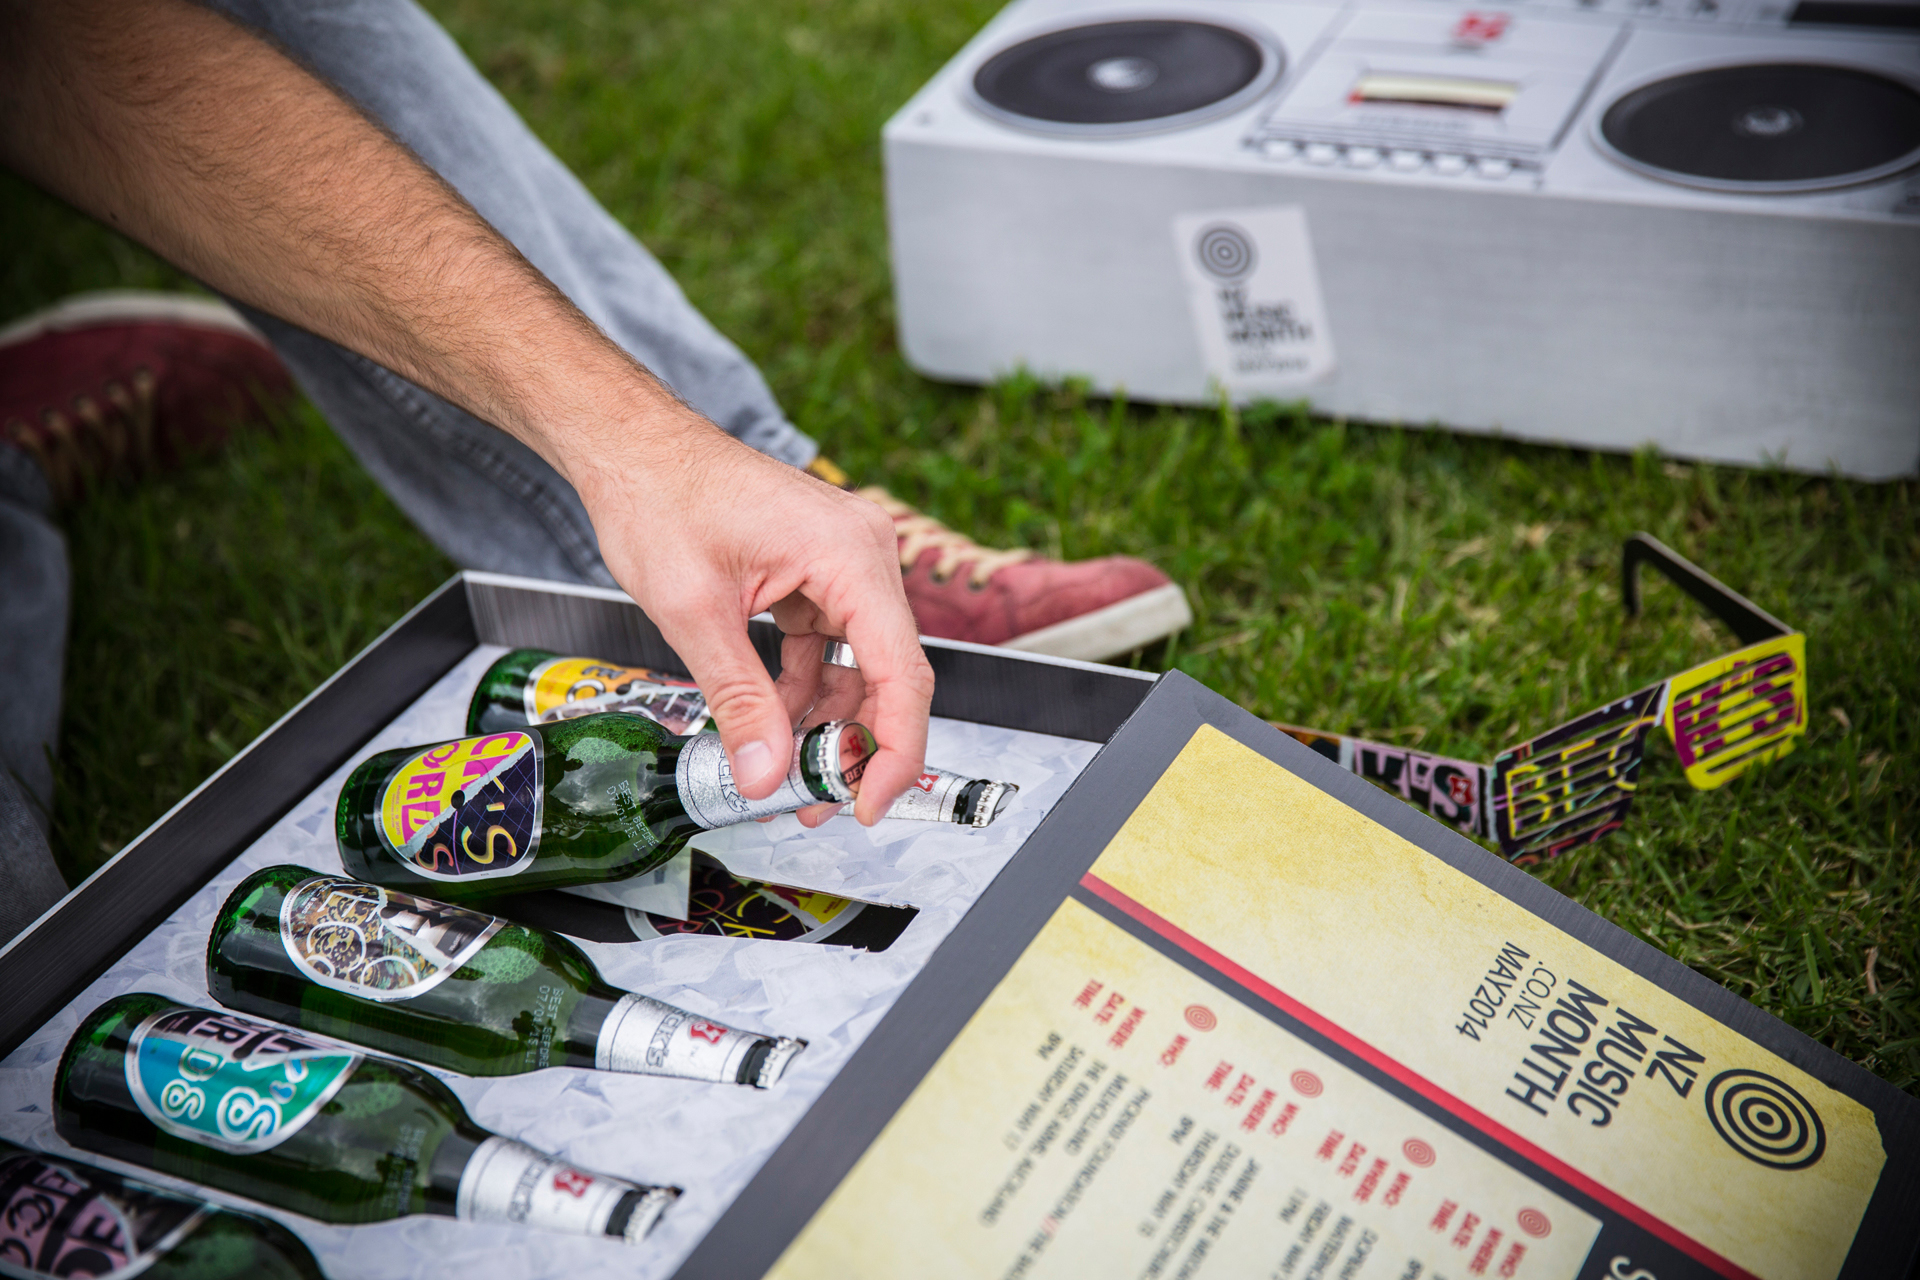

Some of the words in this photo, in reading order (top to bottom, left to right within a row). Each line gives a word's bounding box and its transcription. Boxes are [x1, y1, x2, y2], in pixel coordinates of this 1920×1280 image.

[1072, 978, 1103, 1012] TIME:
[1092, 991, 1125, 1028] DATE:
[1454, 940, 1529, 1042] MAY2014
[1506, 960, 1560, 1030] .CO.NZ
[1105, 1004, 1146, 1053] WHERE:
[1504, 978, 1609, 1117] MONTH
[1156, 1032, 1190, 1071] WHO:
[1562, 1007, 1658, 1131] MUSIC
[1644, 1034, 1706, 1099] NZ
[1202, 1059, 1233, 1095] TIME:
[1222, 1072, 1255, 1111] DATE:
[1237, 1086, 1277, 1136] WHERE:
[1265, 1100, 1300, 1140] WHO:
[1313, 1127, 1344, 1165] TIME:
[1334, 1141, 1367, 1181] DATE:
[1350, 1155, 1389, 1206] WHERE:
[1379, 1169, 1412, 1210] WHO:
[1427, 1197, 1458, 1235] TIME:
[1450, 1211, 1481, 1251] DATE:
